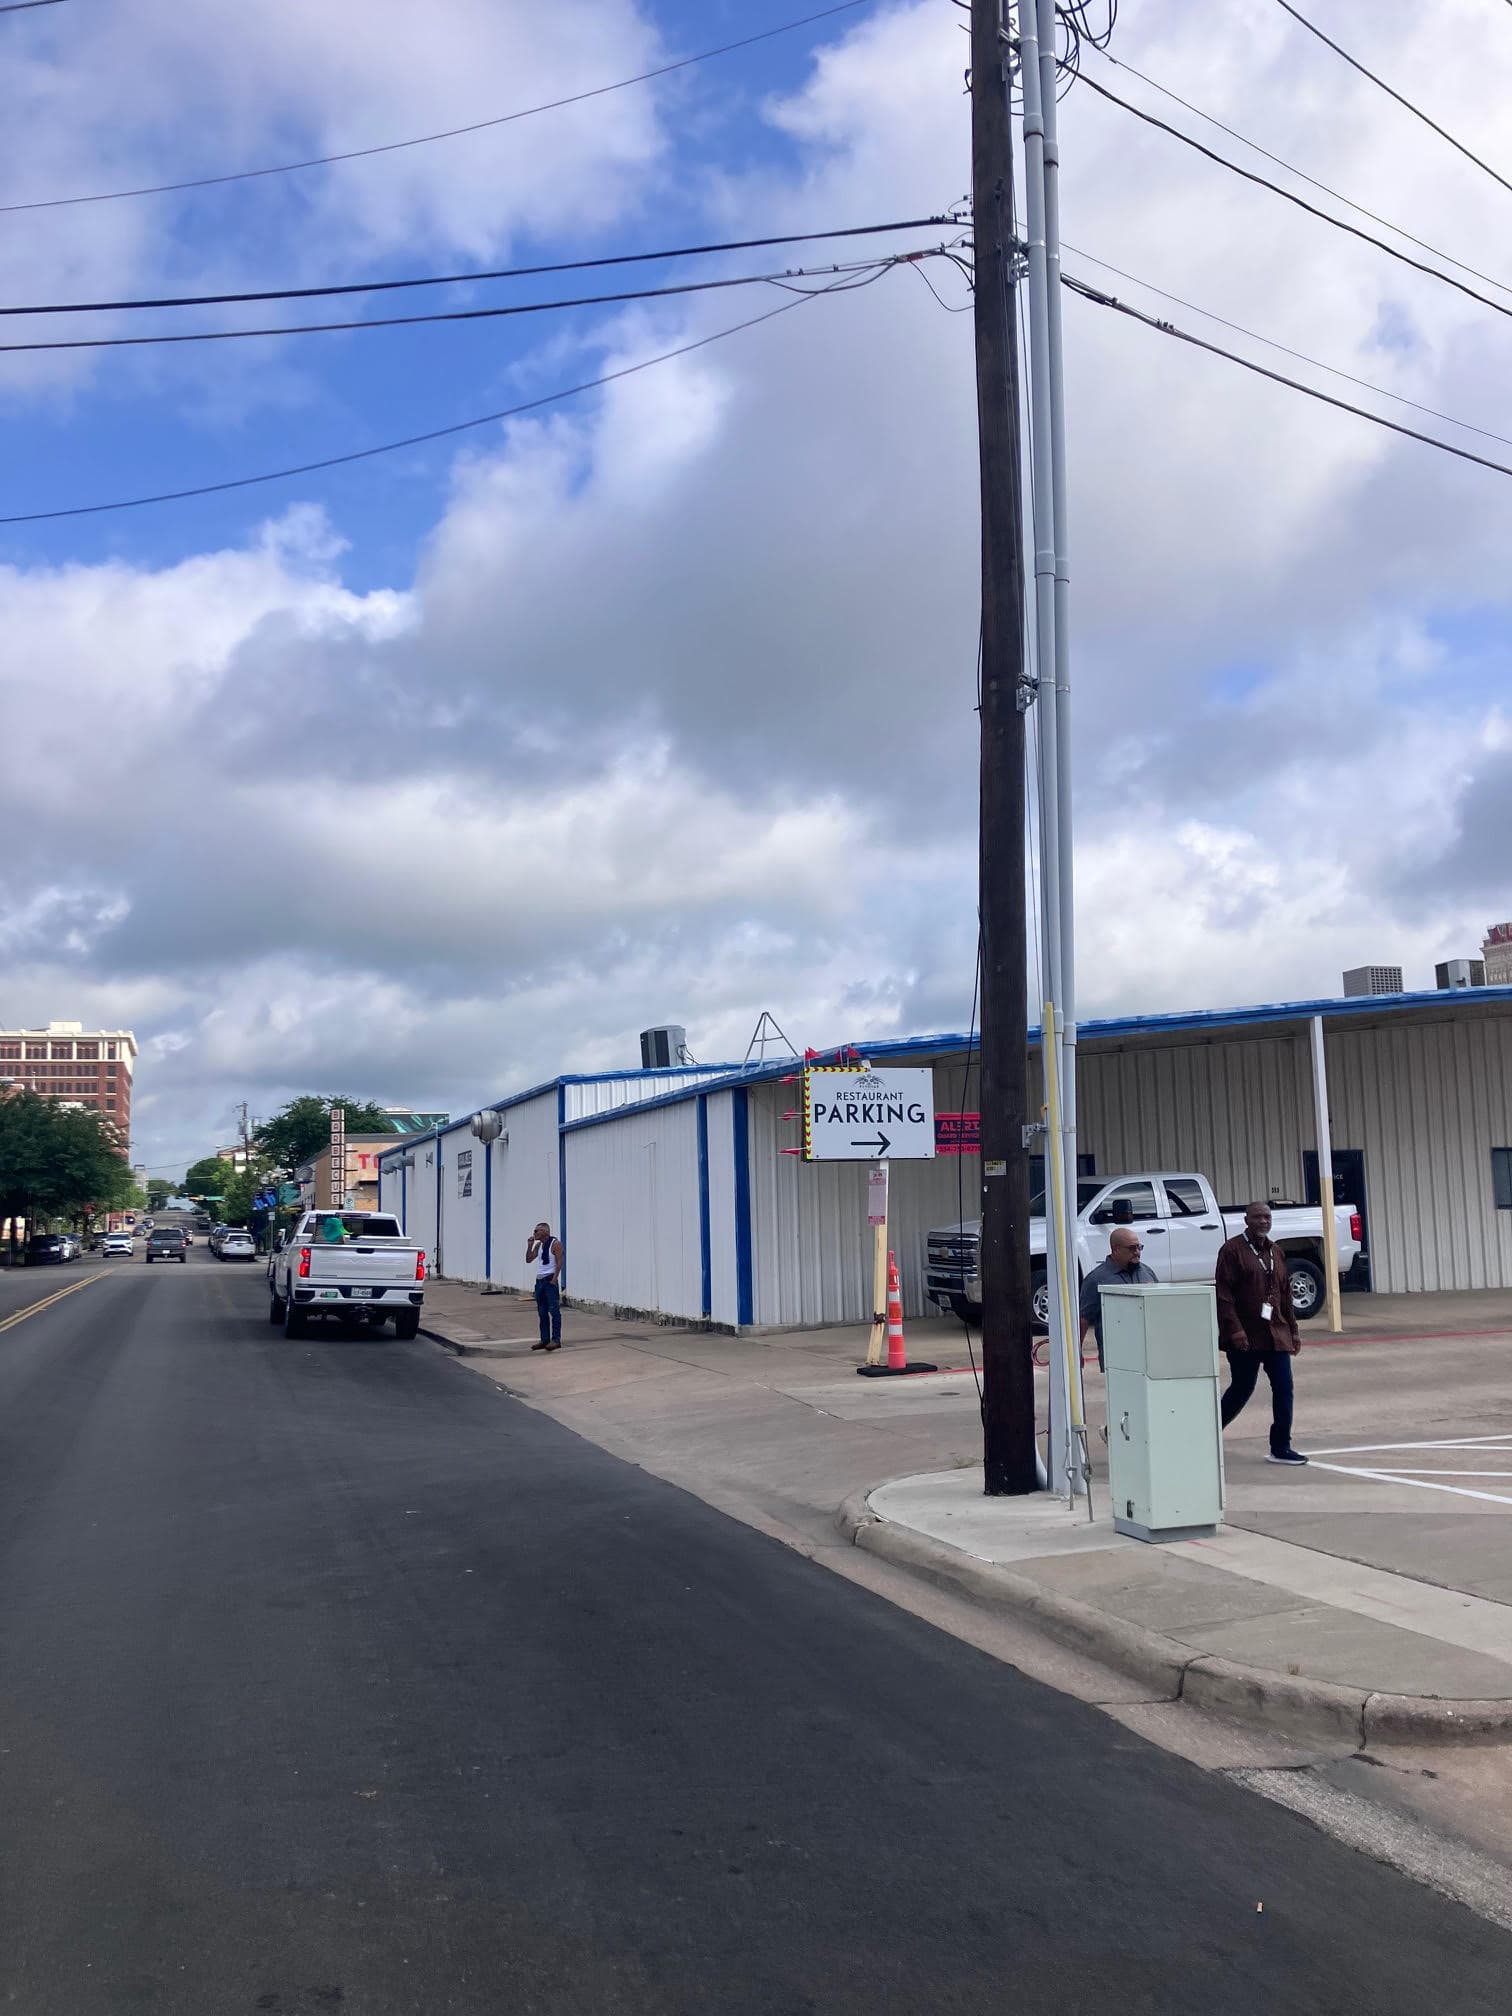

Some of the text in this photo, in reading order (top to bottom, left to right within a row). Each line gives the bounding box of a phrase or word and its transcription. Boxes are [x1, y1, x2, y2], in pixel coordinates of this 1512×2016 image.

[836, 1092, 903, 1101] RESTAURANT
[814, 1103, 926, 1123] PARKING
[940, 1121, 980, 1132] ALERT
[332, 1110, 340, 1203] BARBECUE
